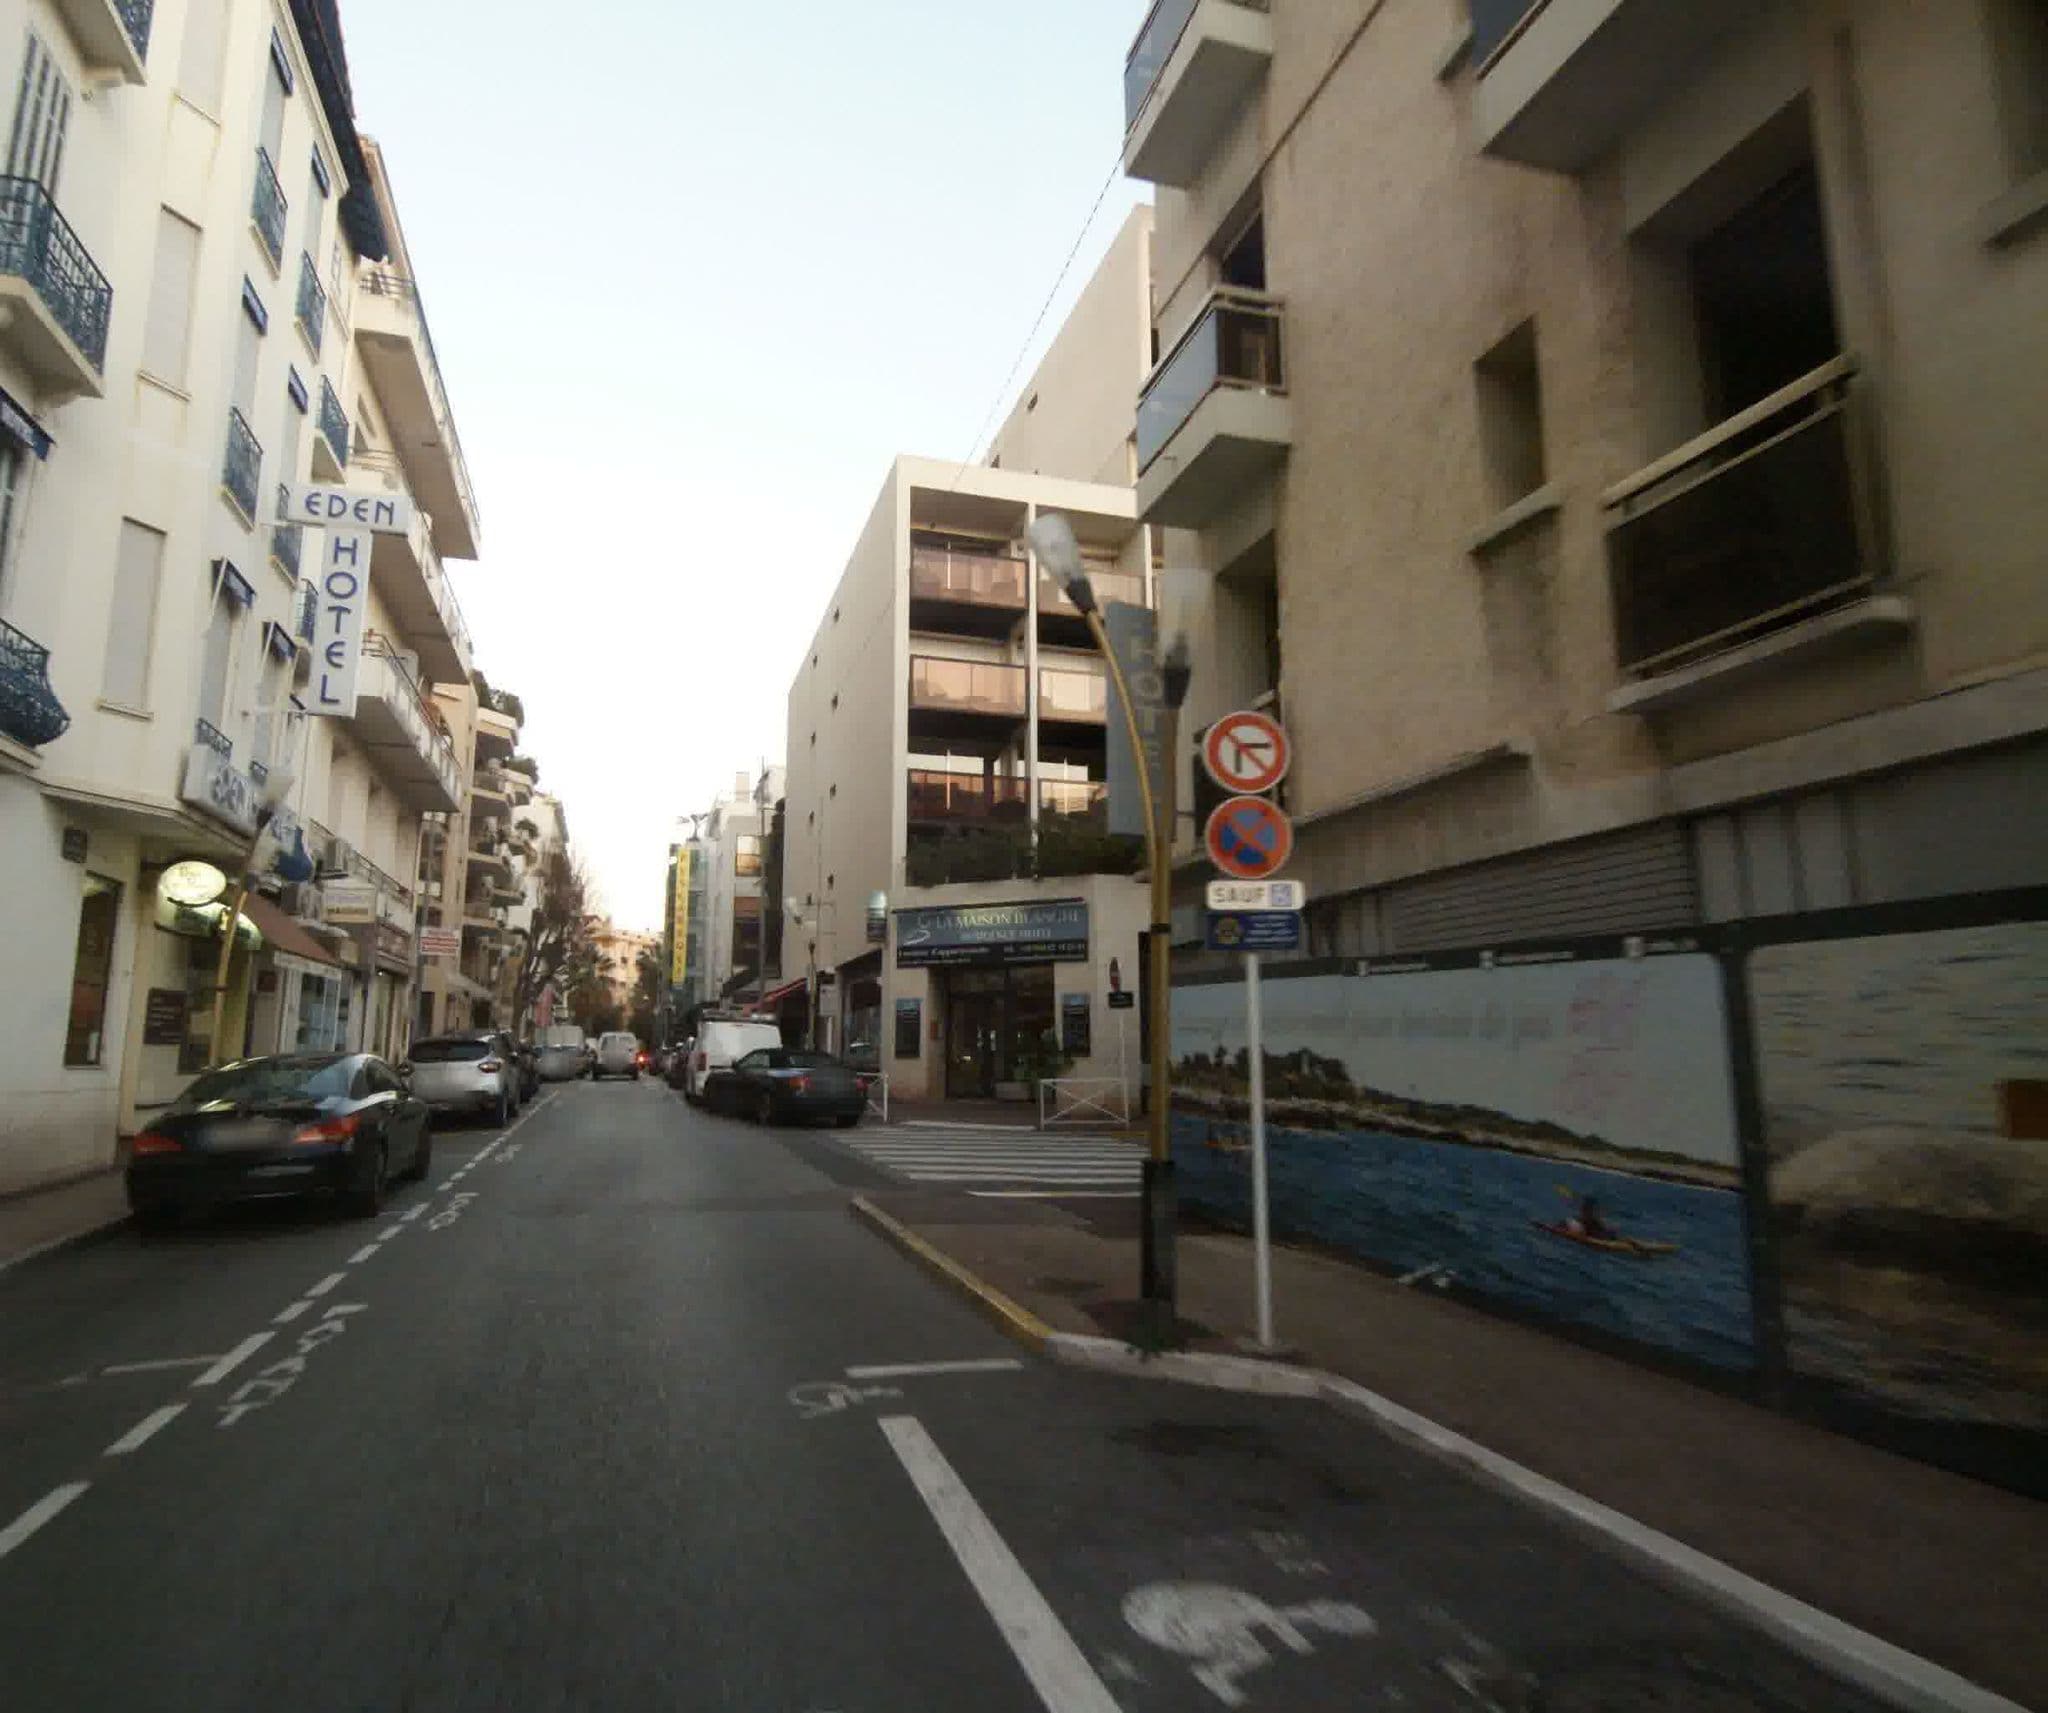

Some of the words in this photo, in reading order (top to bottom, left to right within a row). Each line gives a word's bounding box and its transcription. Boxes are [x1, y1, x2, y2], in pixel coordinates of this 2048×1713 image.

[305, 492, 395, 526] EDEN
[320, 535, 358, 704] HOTEL
[956, 912, 1010, 929] MAISON
